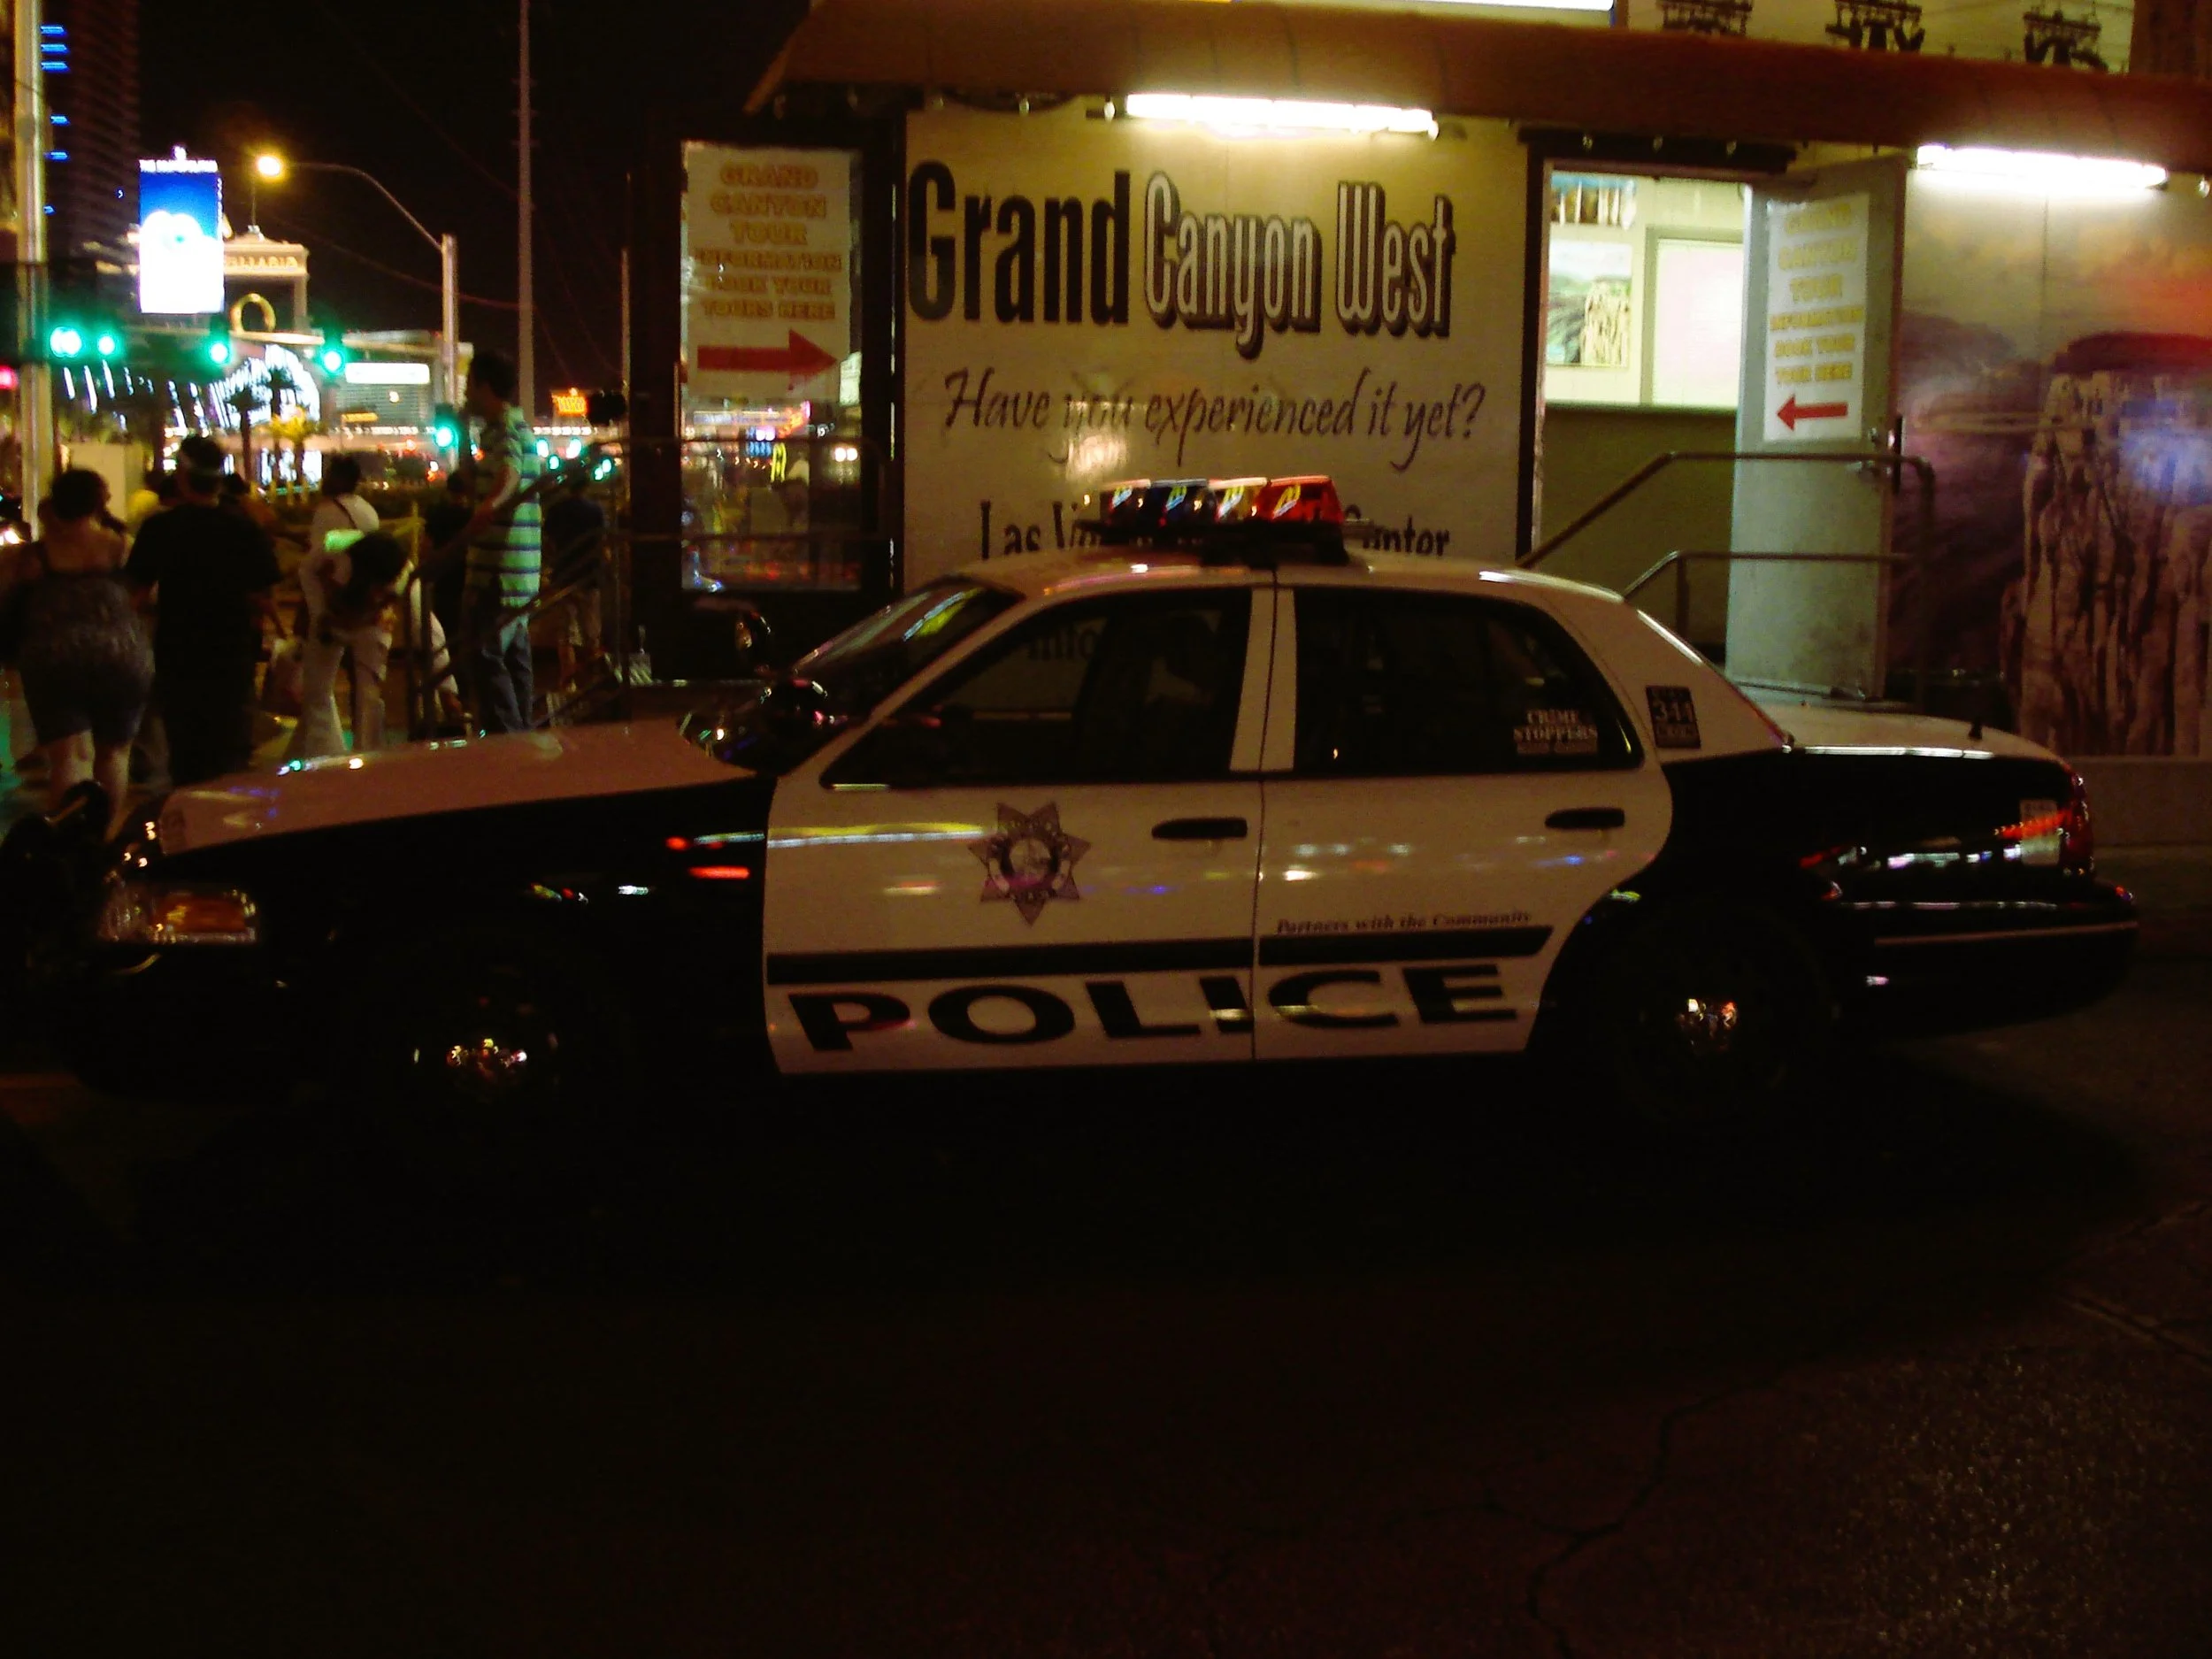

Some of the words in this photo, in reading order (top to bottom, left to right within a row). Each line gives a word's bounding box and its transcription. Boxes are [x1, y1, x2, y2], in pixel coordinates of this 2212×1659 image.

[908, 161, 1131, 322] Grand
[1145, 172, 1322, 359] Canyon
[1336, 181, 1455, 337] West
[944, 366, 1050, 428] Have
[1145, 367, 1370, 467] experienced
[1369, 381, 1397, 437] it
[1389, 382, 1486, 473] yet?
[1512, 725, 1599, 742] STOPPERS
[1356, 915, 1394, 929] with
[1400, 913, 1425, 927] the
[787, 964, 1519, 1051] POLICE
